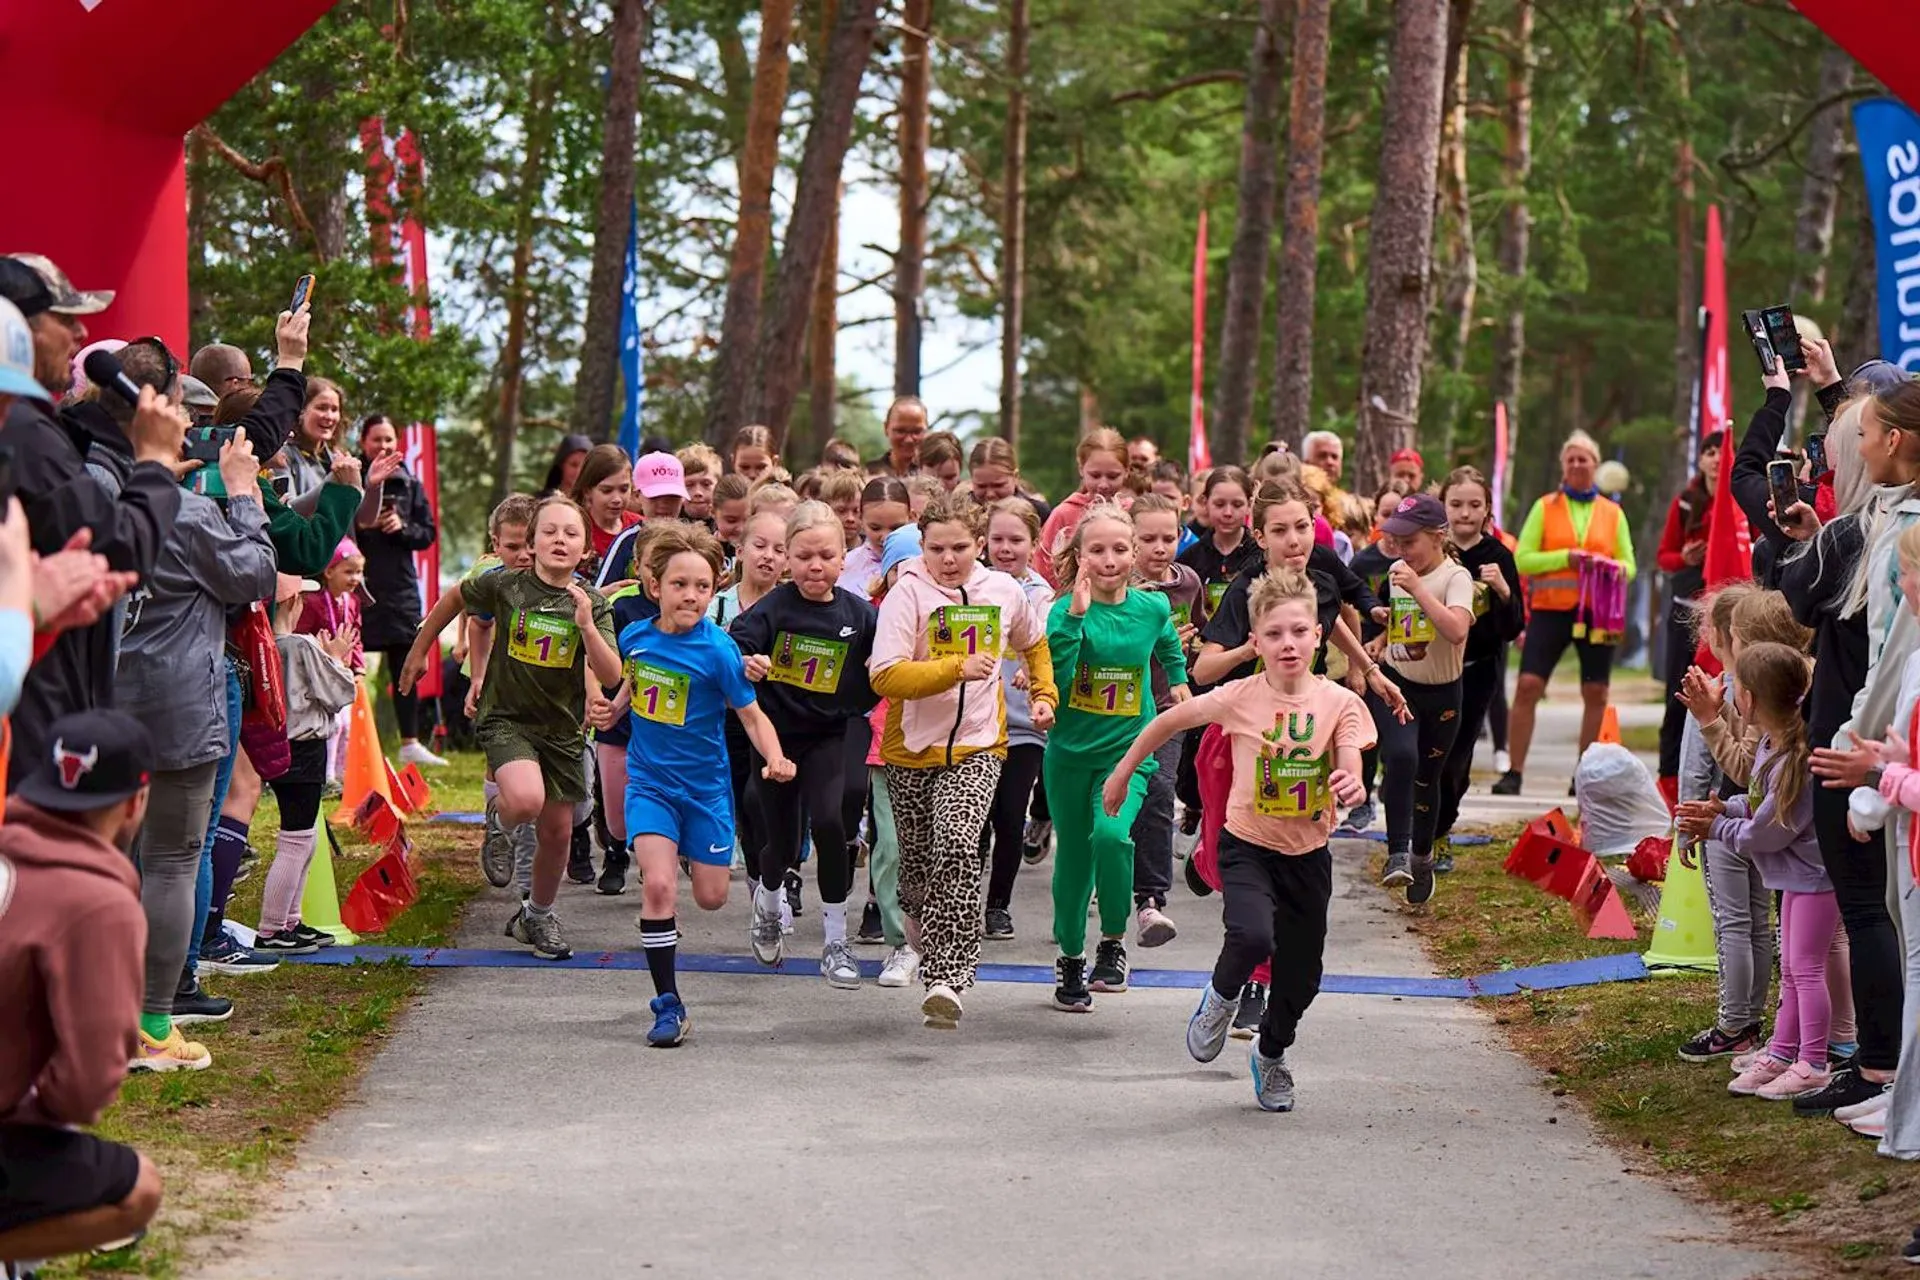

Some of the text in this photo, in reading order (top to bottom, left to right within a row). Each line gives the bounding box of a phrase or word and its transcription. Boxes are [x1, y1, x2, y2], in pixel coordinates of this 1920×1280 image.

[959, 624, 978, 654] 1
[1400, 612, 1412, 638] 1
[534, 634, 552, 662] 1
[800, 656, 819, 685] 1
[642, 684, 660, 716] 1
[1099, 681, 1118, 712] 1
[1261, 712, 1315, 742] JU
[1287, 780, 1308, 811] 1
